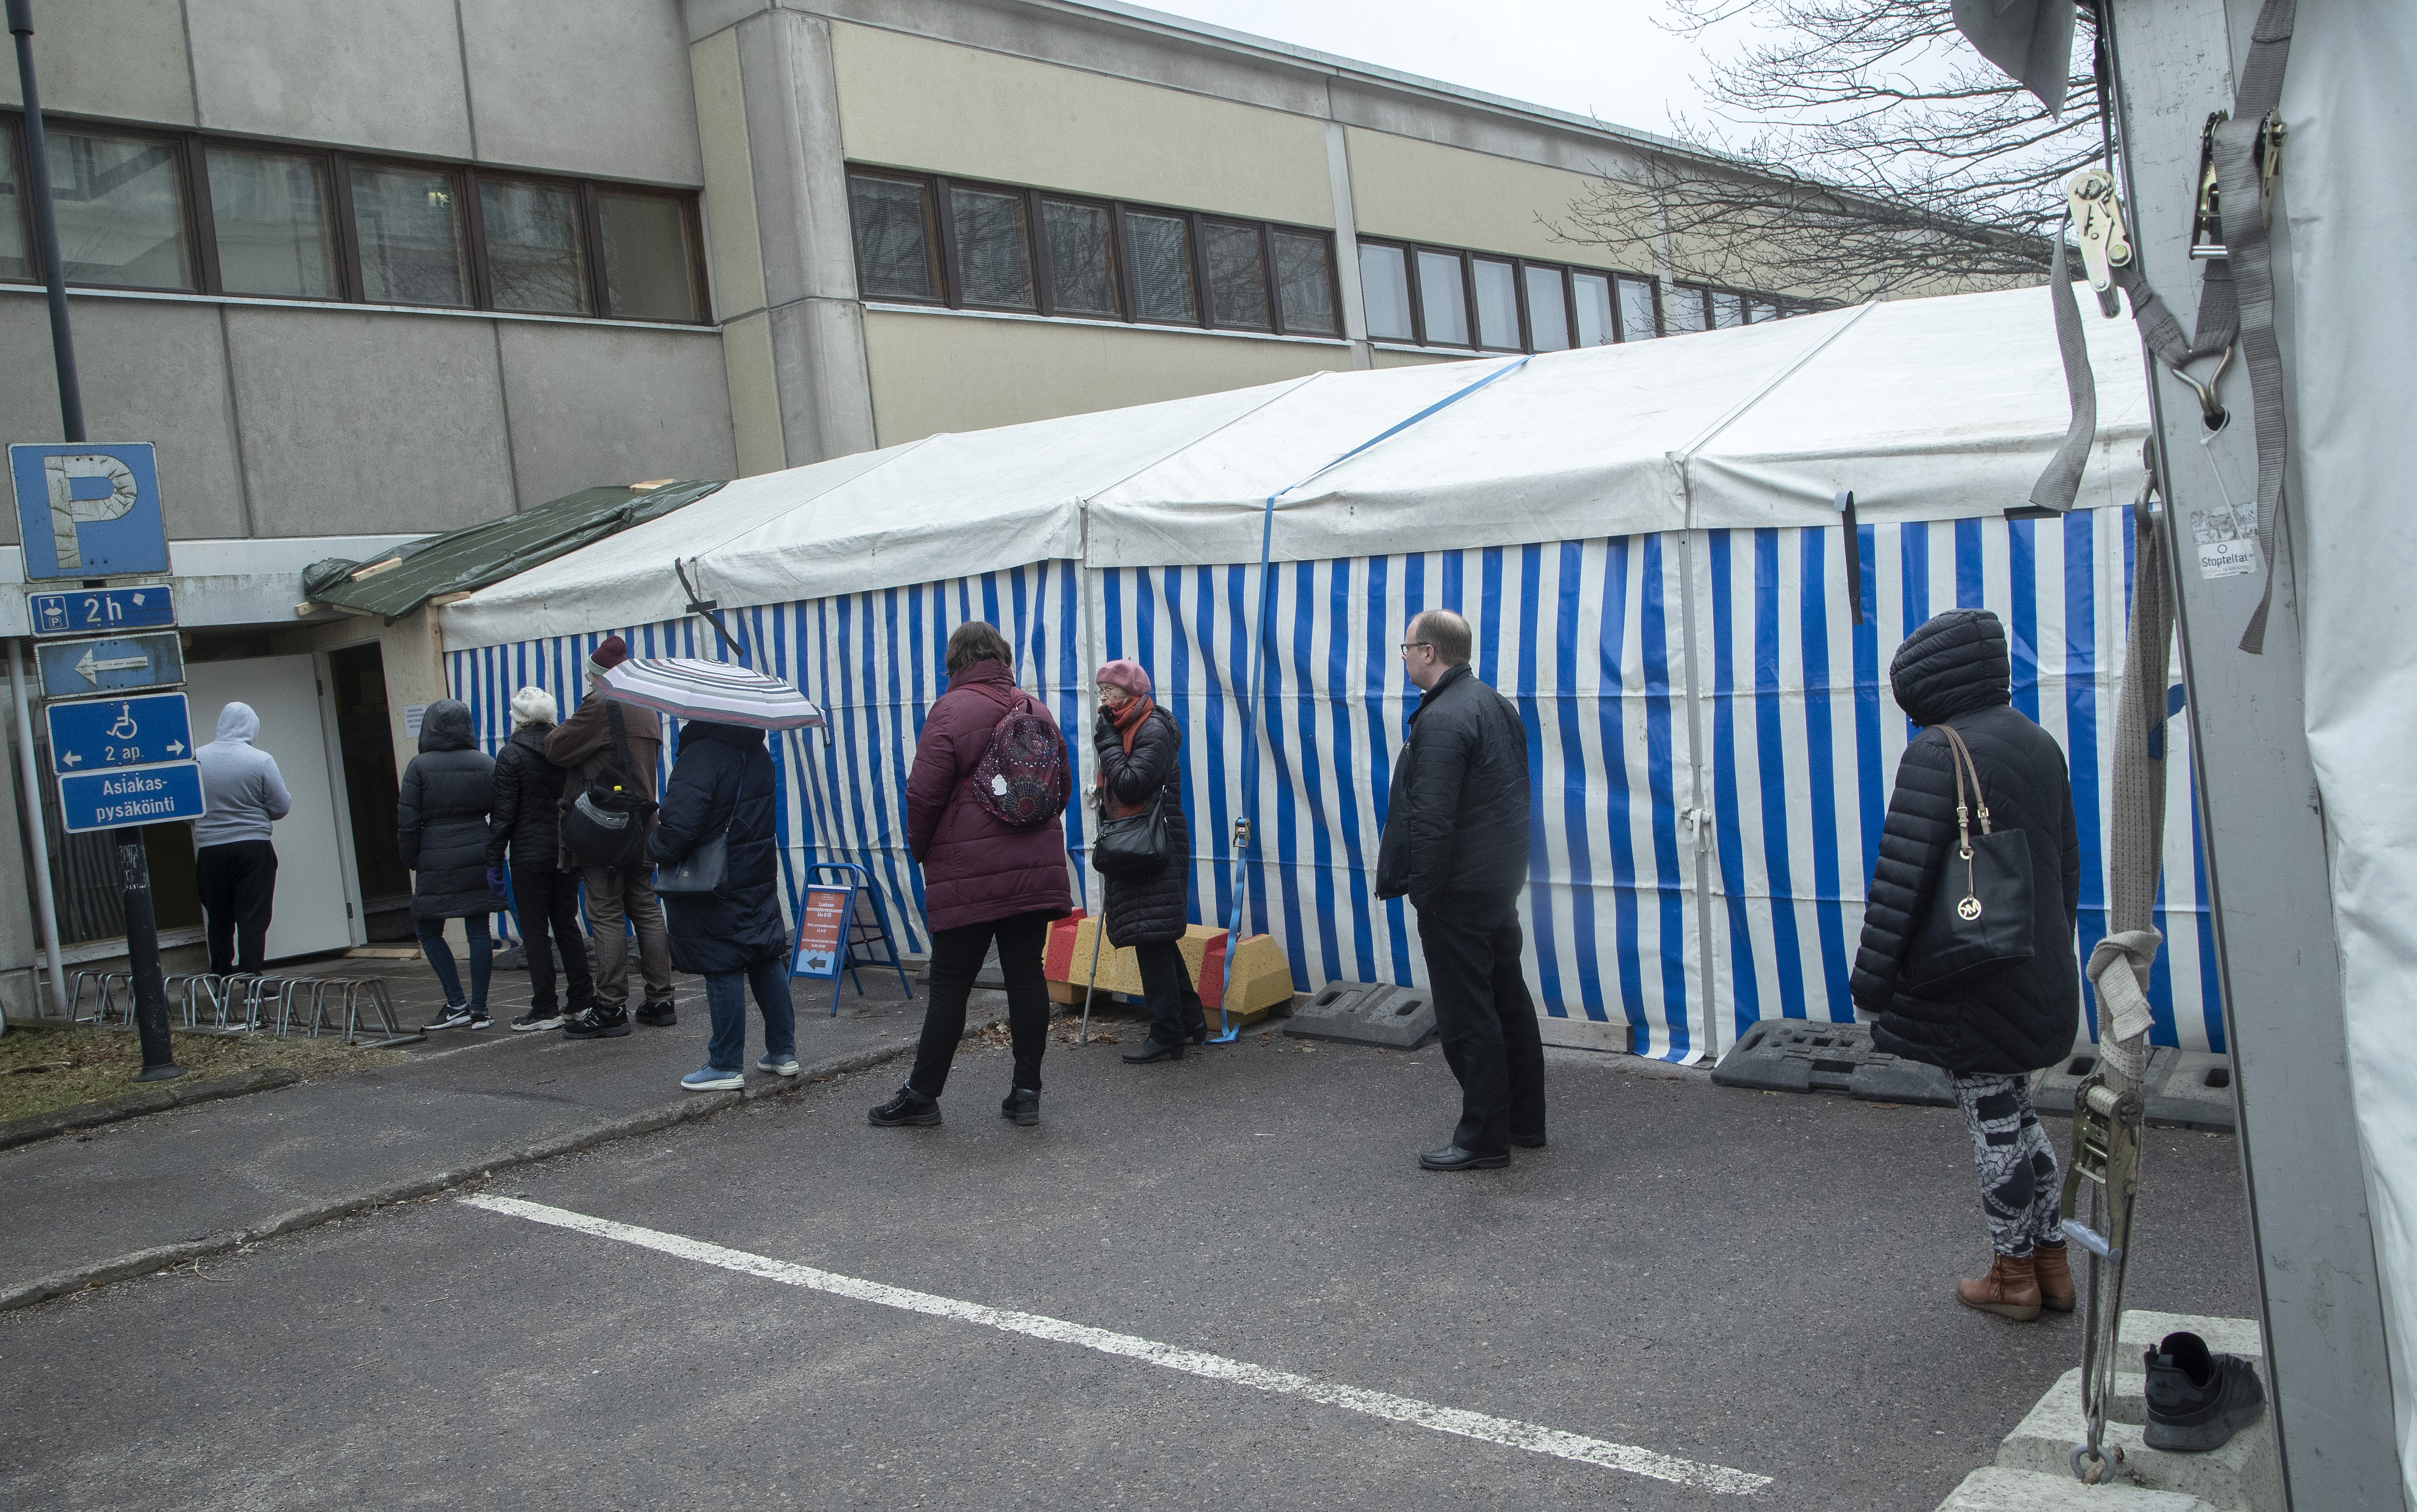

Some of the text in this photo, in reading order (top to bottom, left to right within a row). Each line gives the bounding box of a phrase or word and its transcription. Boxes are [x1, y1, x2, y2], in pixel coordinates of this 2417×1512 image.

[44, 454, 138, 569] P
[84, 597, 123, 623] 2 h
[105, 746, 144, 761] 2 ap.
[103, 777, 167, 796] Asiakas-
[96, 796, 175, 822] pysäköinti
